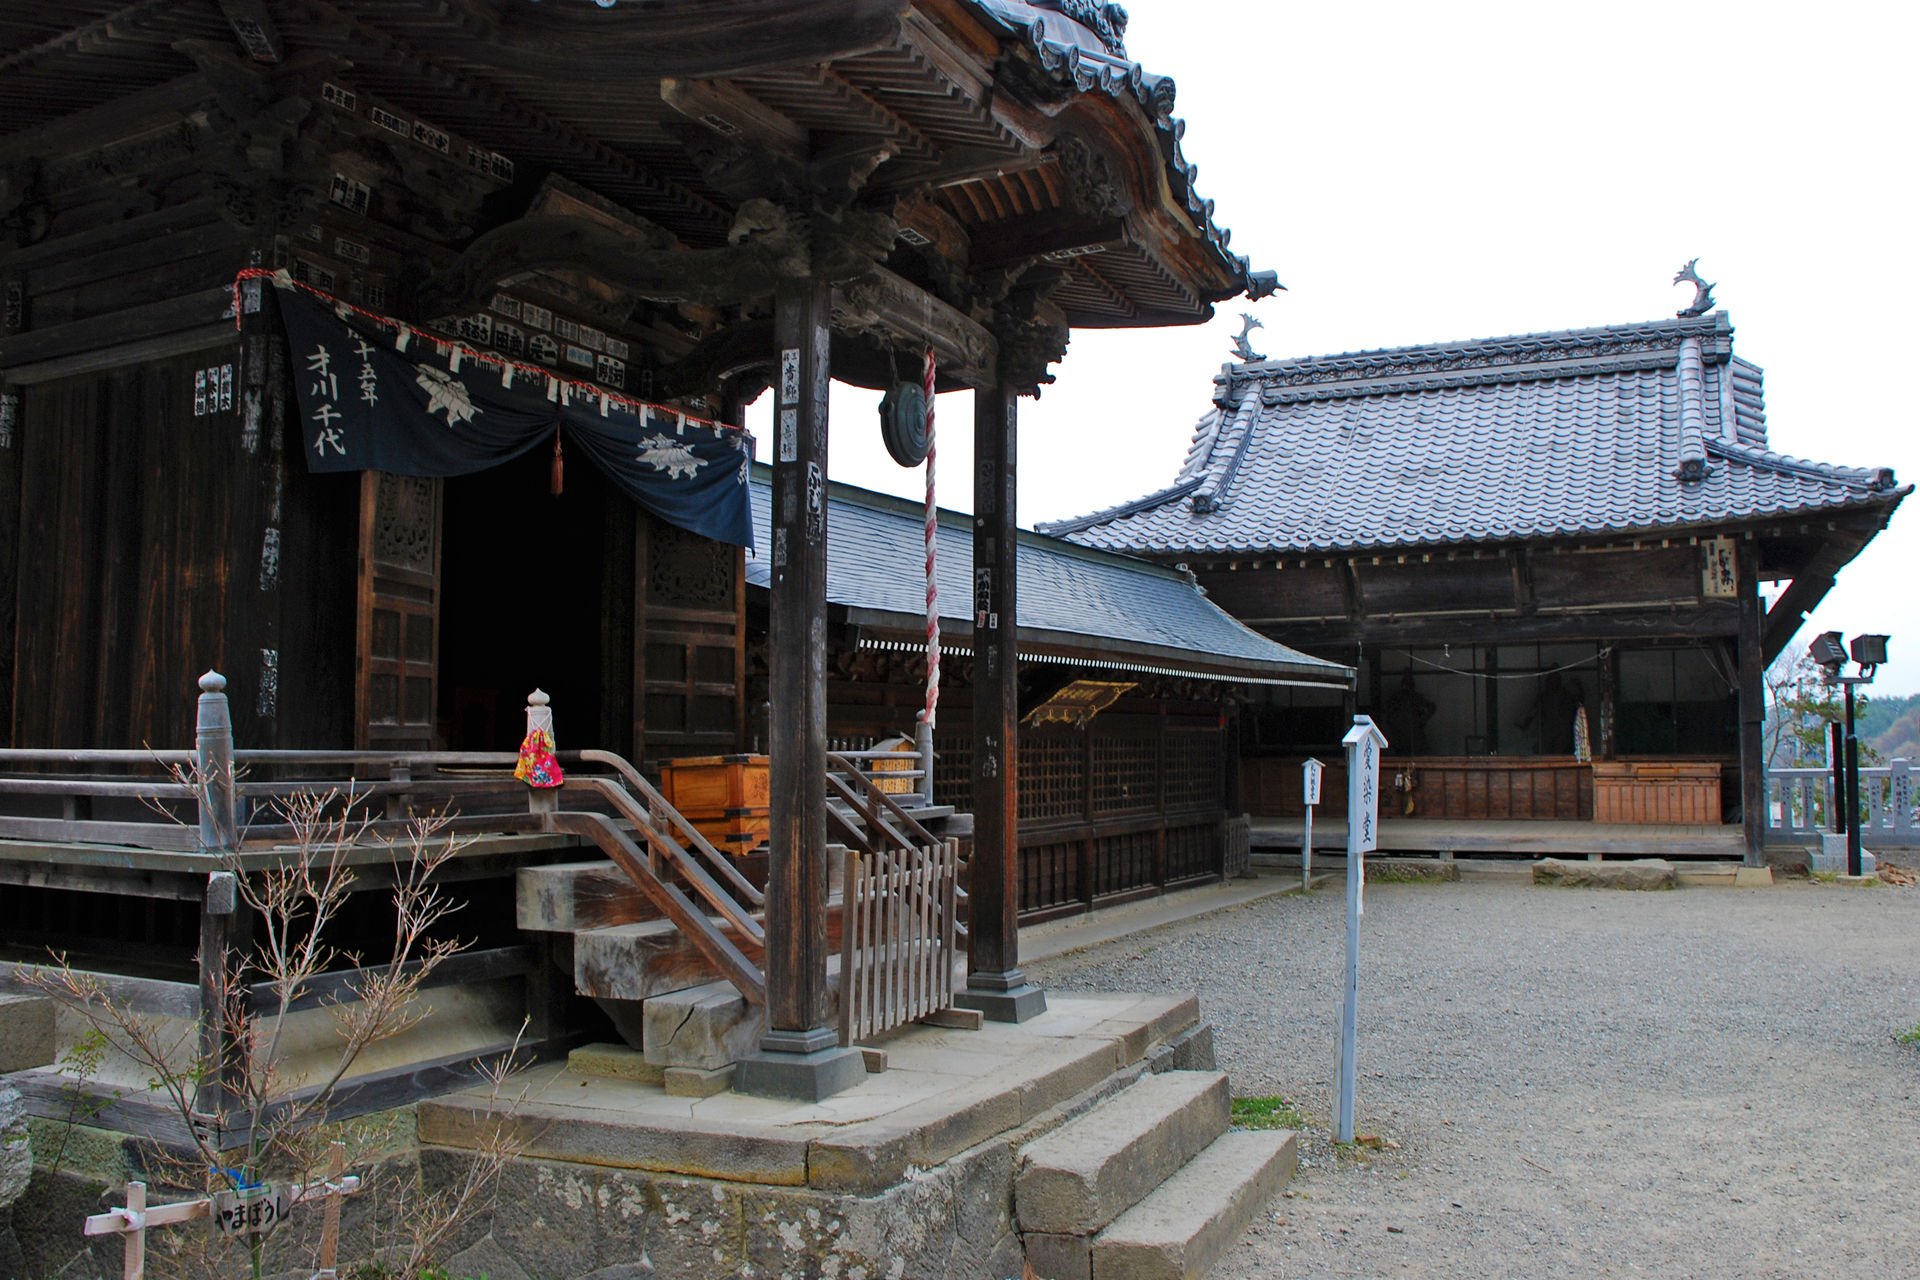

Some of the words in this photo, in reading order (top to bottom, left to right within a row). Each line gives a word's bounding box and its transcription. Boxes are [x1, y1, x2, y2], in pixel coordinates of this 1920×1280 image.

[306, 344, 346, 457] 才川千代
[215, 1197, 286, 1229] やまぼうし
